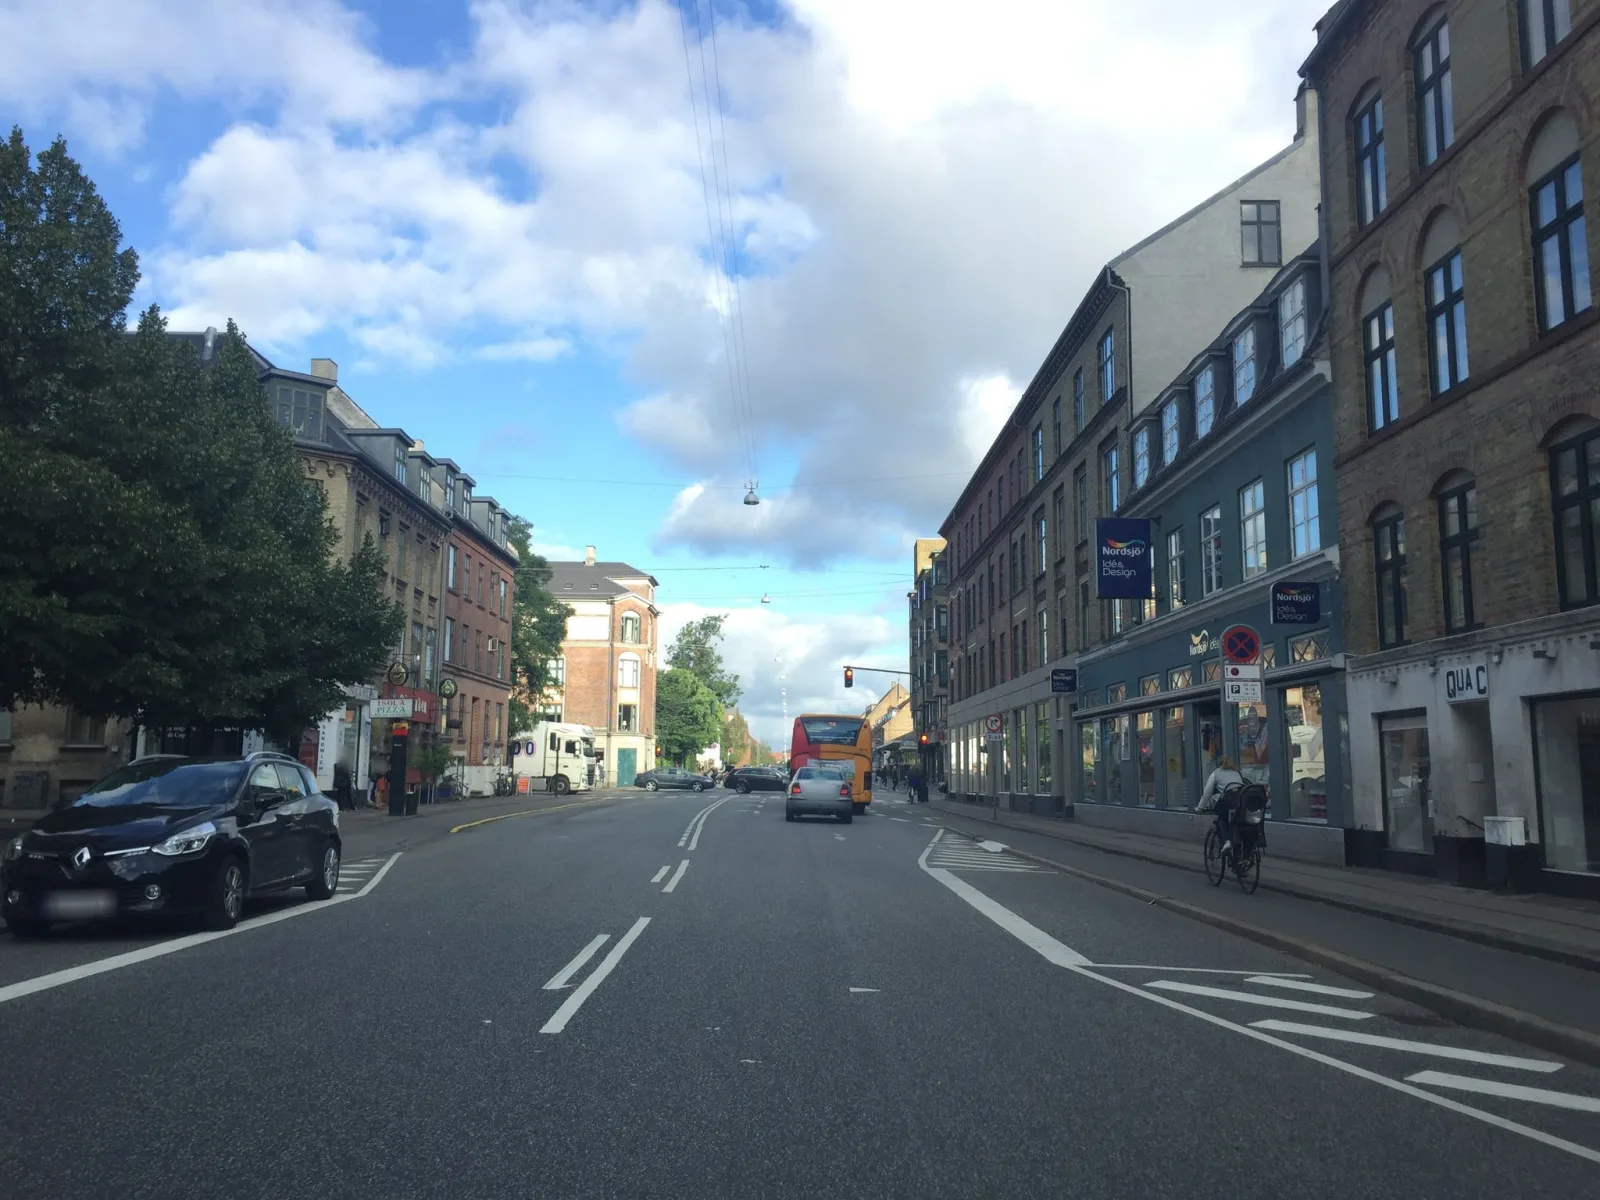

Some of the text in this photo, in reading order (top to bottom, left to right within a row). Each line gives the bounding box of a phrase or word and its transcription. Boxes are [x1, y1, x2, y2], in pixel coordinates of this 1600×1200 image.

[1102, 546, 1141, 558] Nordsjö
[1102, 568, 1137, 579] Design
[1276, 592, 1312, 603] Nordsjö
[1276, 612, 1308, 621] Design
[376, 706, 406, 714] PIZZA
